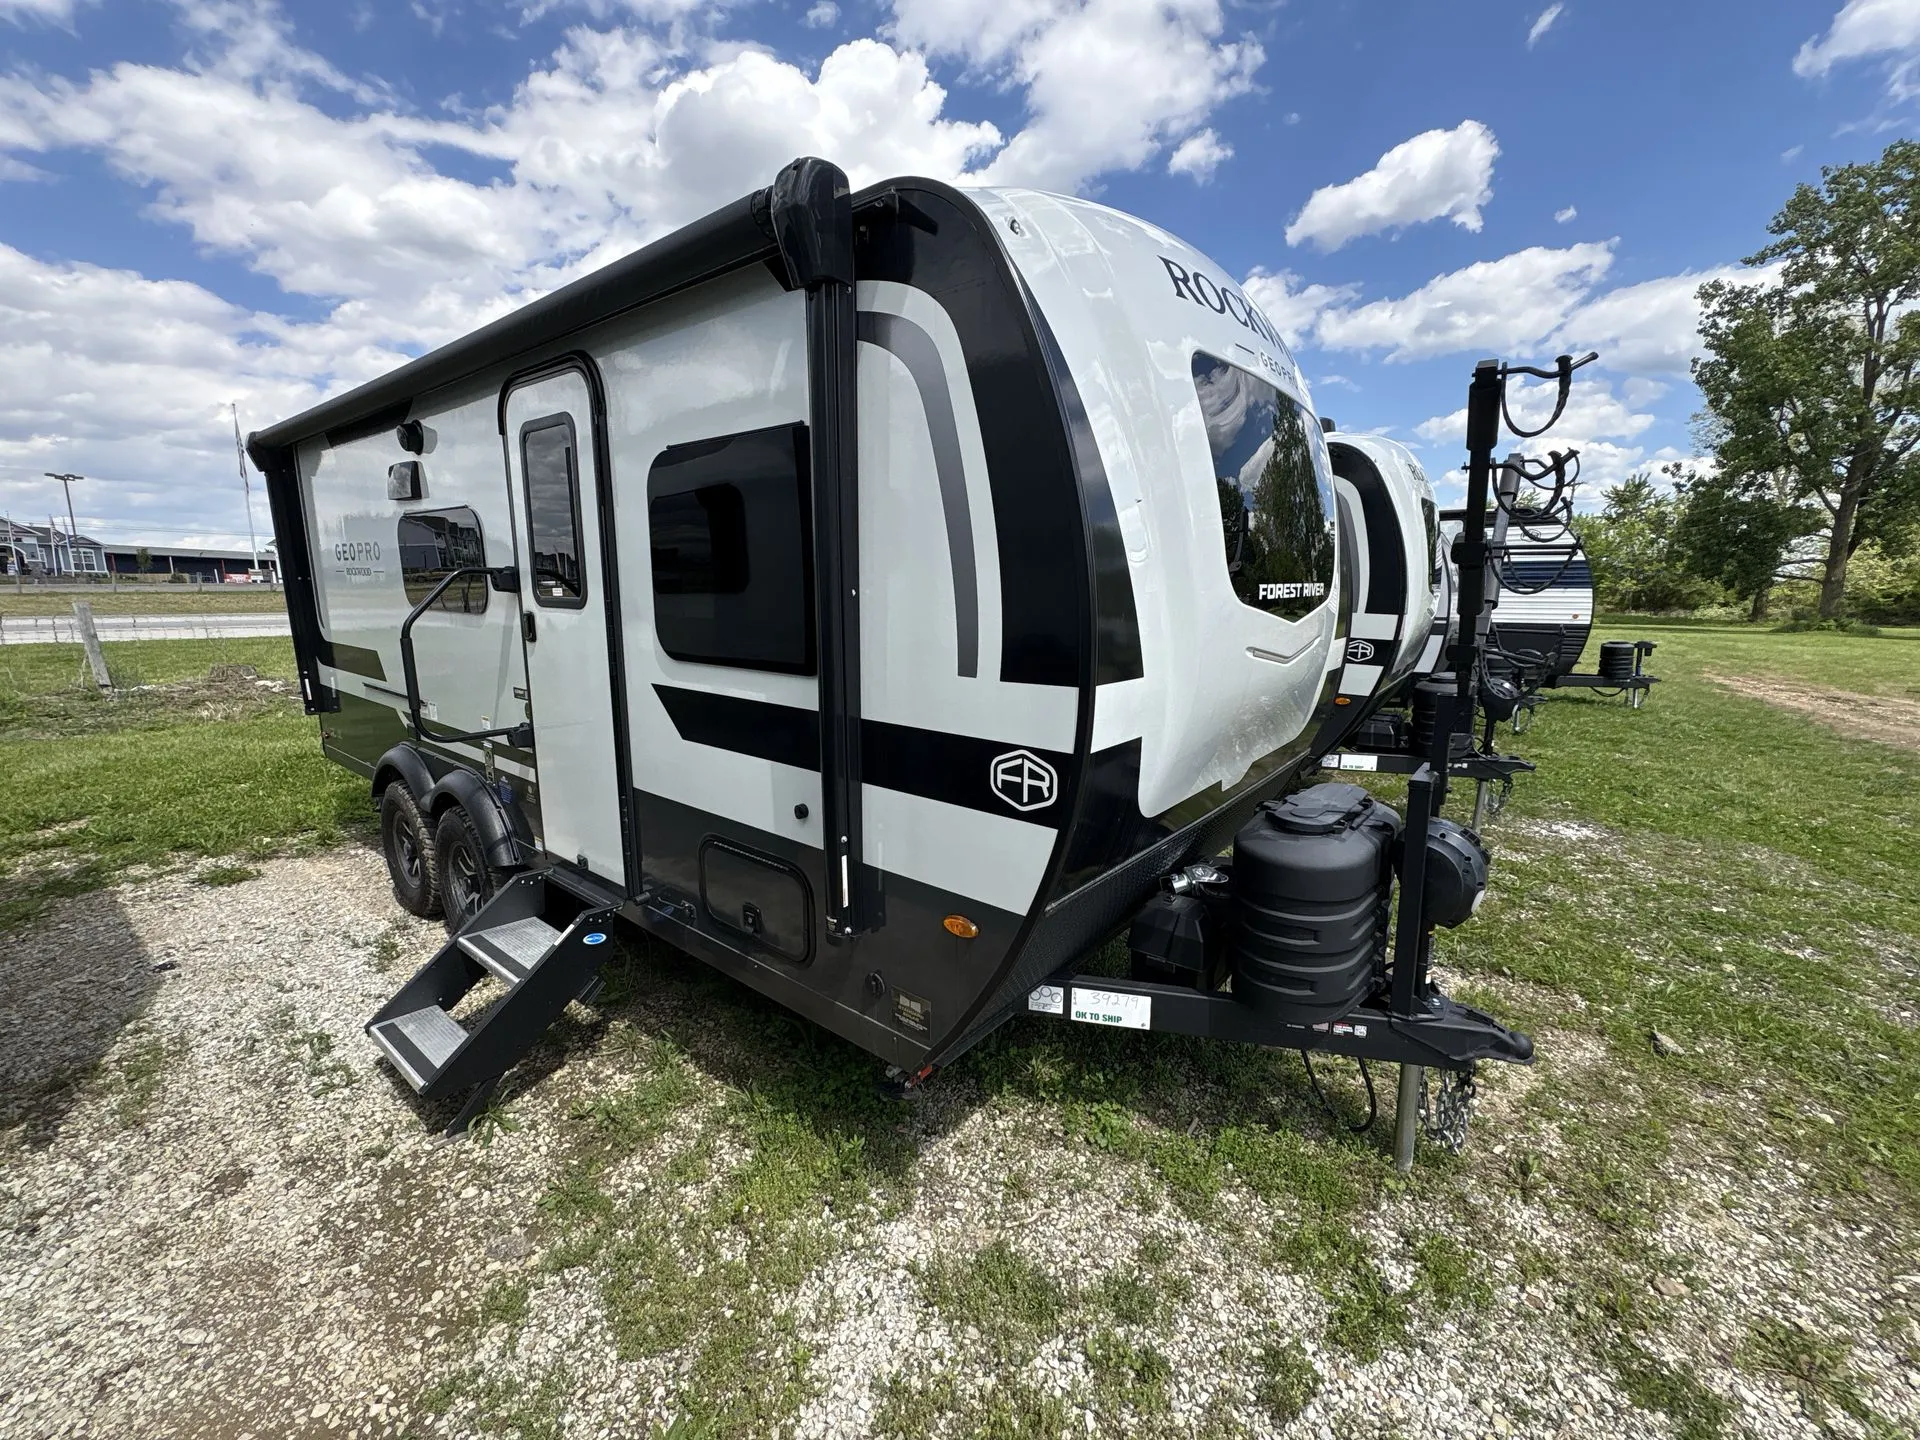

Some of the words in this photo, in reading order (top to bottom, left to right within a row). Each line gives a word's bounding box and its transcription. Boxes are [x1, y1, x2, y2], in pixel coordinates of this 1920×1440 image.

[1157, 254, 1295, 367] ROCKW
[335, 541, 381, 561] GEOPRO
[1258, 583, 1302, 600] FOREST
[1303, 582, 1325, 597] RIVER
[1089, 991, 1139, 1009] 39279
[1075, 1010, 1087, 1019] OK
[1089, 1012, 1100, 1021] TO
[1102, 1014, 1122, 1024] SHIP
